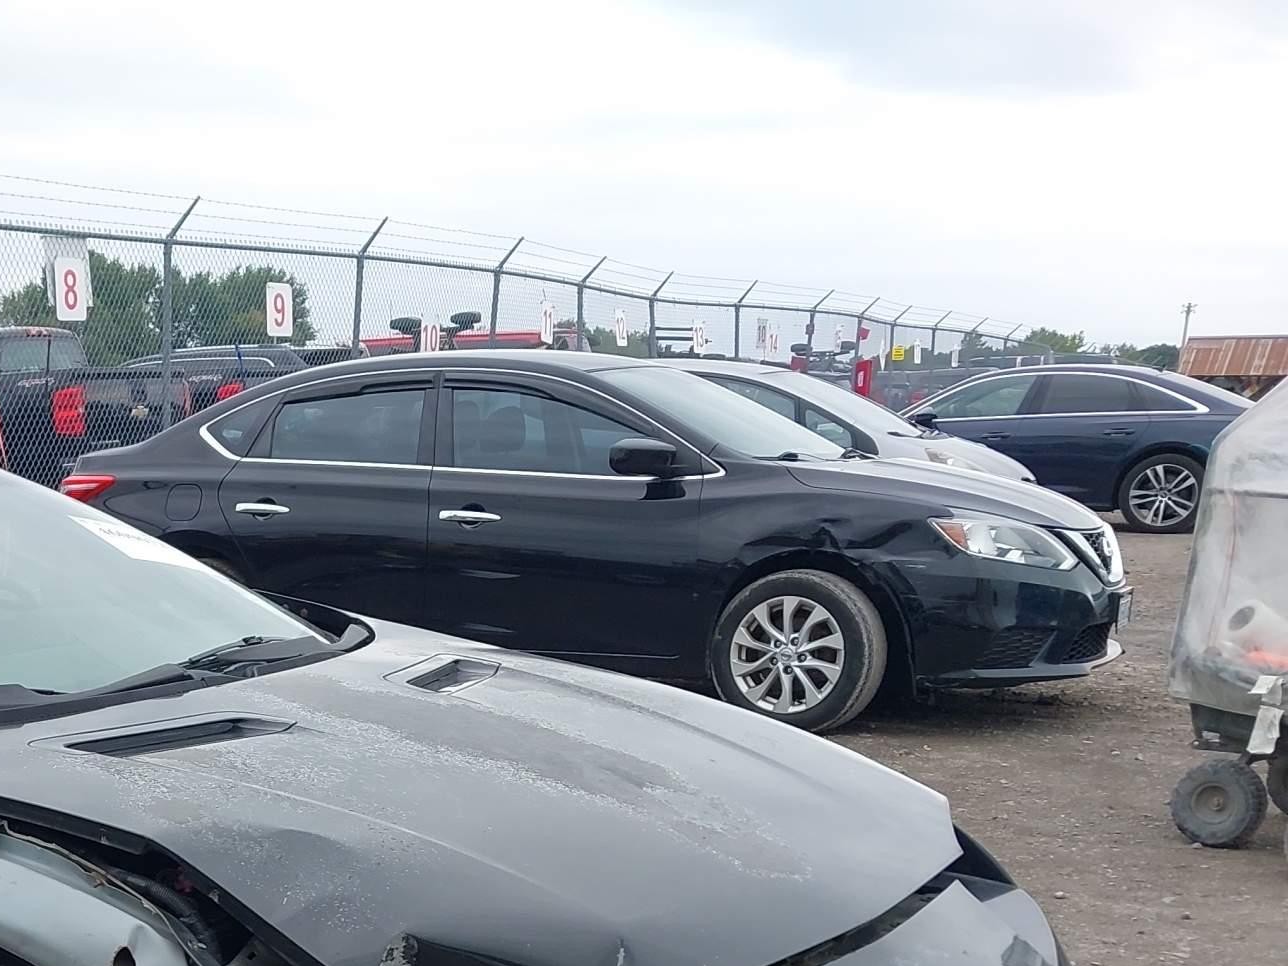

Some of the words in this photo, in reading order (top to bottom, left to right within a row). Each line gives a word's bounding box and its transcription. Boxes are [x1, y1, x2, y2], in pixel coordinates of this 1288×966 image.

[63, 269, 78, 311] 8
[273, 292, 285, 328] 9
[543, 309, 552, 337] 11
[423, 324, 438, 352] 10
[694, 326, 704, 348] 13
